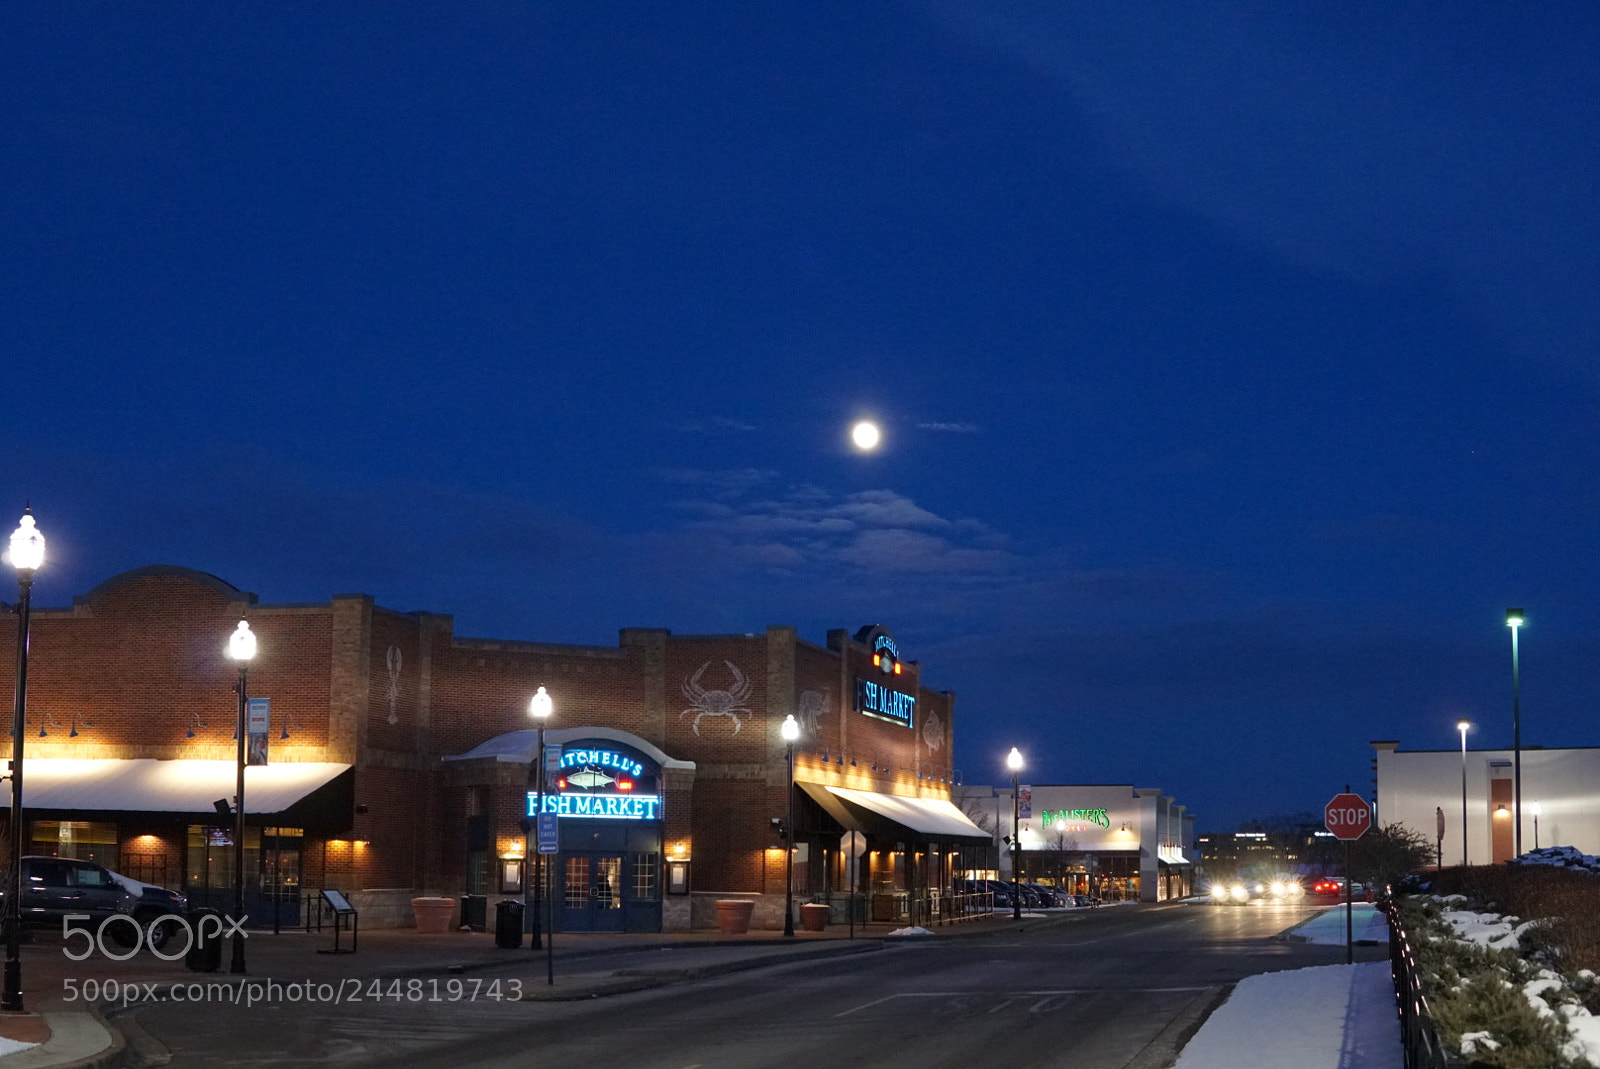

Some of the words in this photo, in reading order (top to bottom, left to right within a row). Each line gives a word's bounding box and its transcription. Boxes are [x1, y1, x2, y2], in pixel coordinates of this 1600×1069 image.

[880, 686, 916, 729] MARKET
[560, 750, 643, 777] ITCHELL'S
[527, 795, 571, 817] FISH
[575, 796, 659, 820] MARKET
[1328, 808, 1368, 826] STOP
